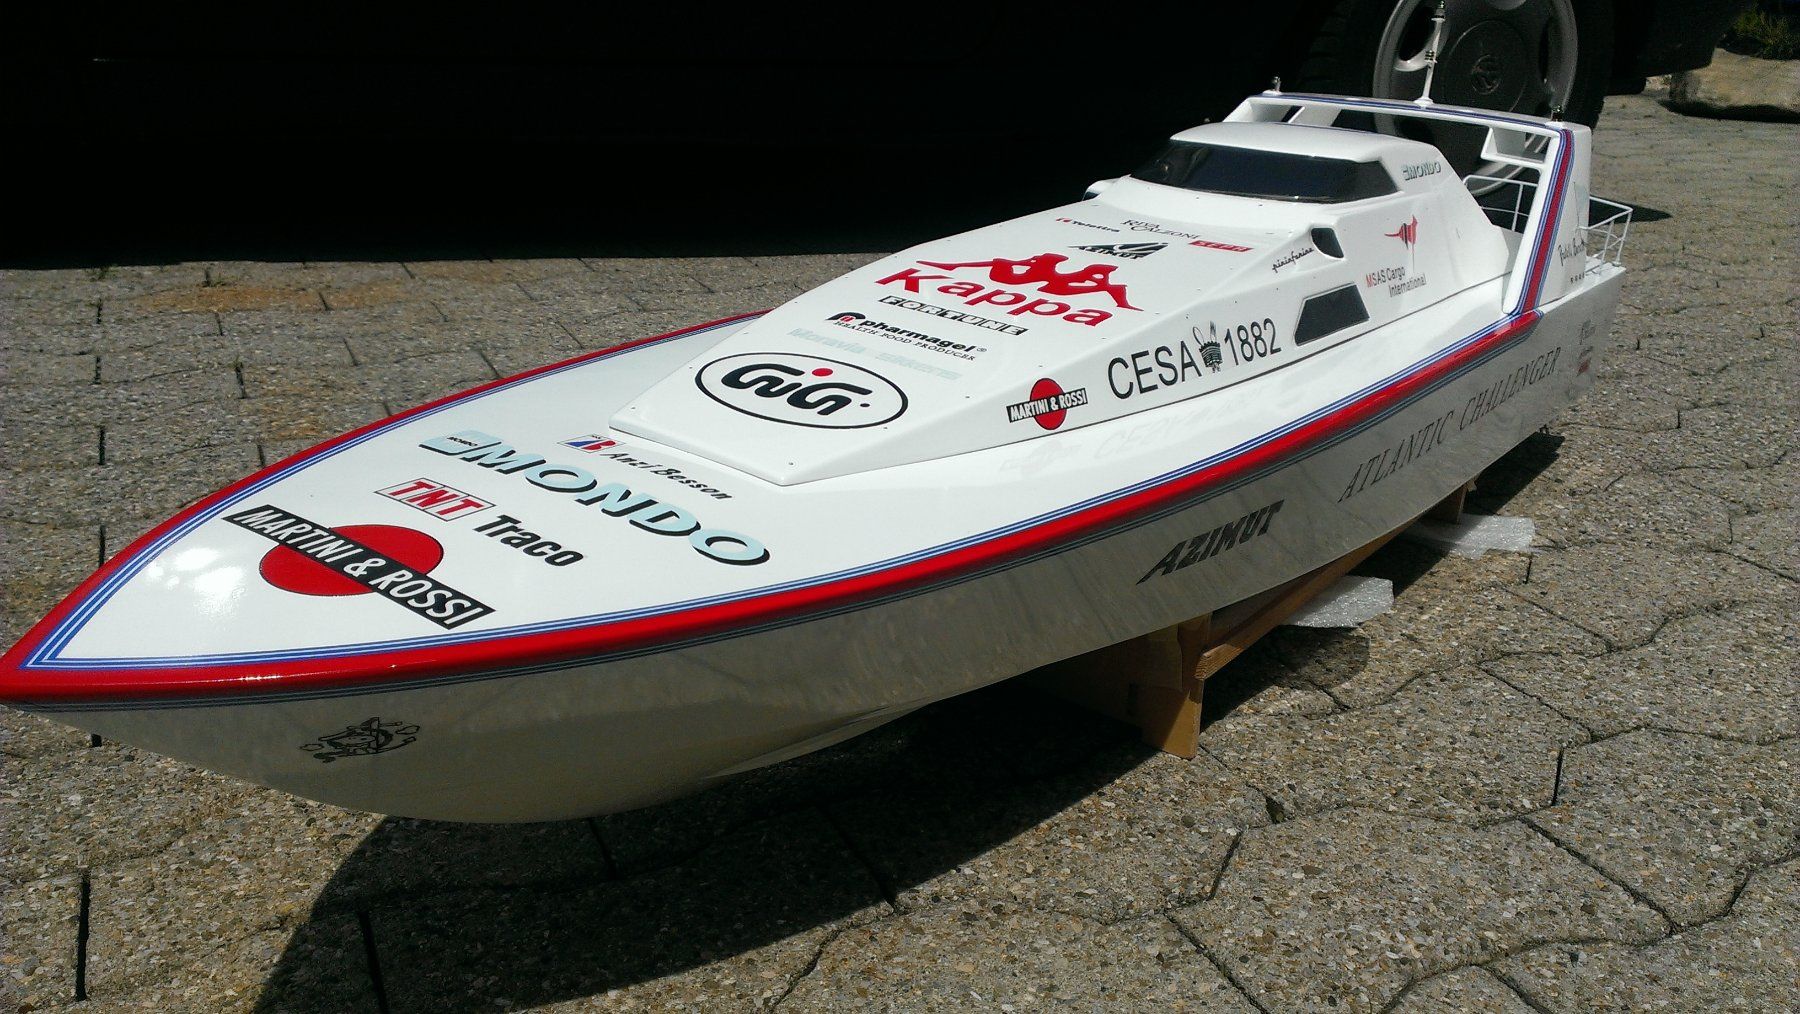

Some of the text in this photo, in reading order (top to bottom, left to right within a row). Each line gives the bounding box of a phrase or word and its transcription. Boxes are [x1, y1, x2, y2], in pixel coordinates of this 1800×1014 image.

[874, 267, 1113, 327] Kappa
[1365, 266, 1406, 288] MSAS Cargo
[1389, 273, 1427, 298] International
[878, 295, 1029, 336] FORTUNE
[833, 321, 976, 362] HEALTH FOOD PRODUCER
[1107, 317, 1283, 400] CESA 1882
[1009, 389, 1087, 422] MARTINI & ROSSI
[1337, 346, 1562, 503] ATLANTIC CHALLENGER
[388, 480, 485, 516] TNT
[600, 452, 733, 500] Anzi Besson
[458, 442, 771, 566] MONDO
[472, 514, 584, 567] Traco
[1136, 499, 1285, 586] AZIMUT
[232, 509, 484, 625] MARTINI & ROSSI
